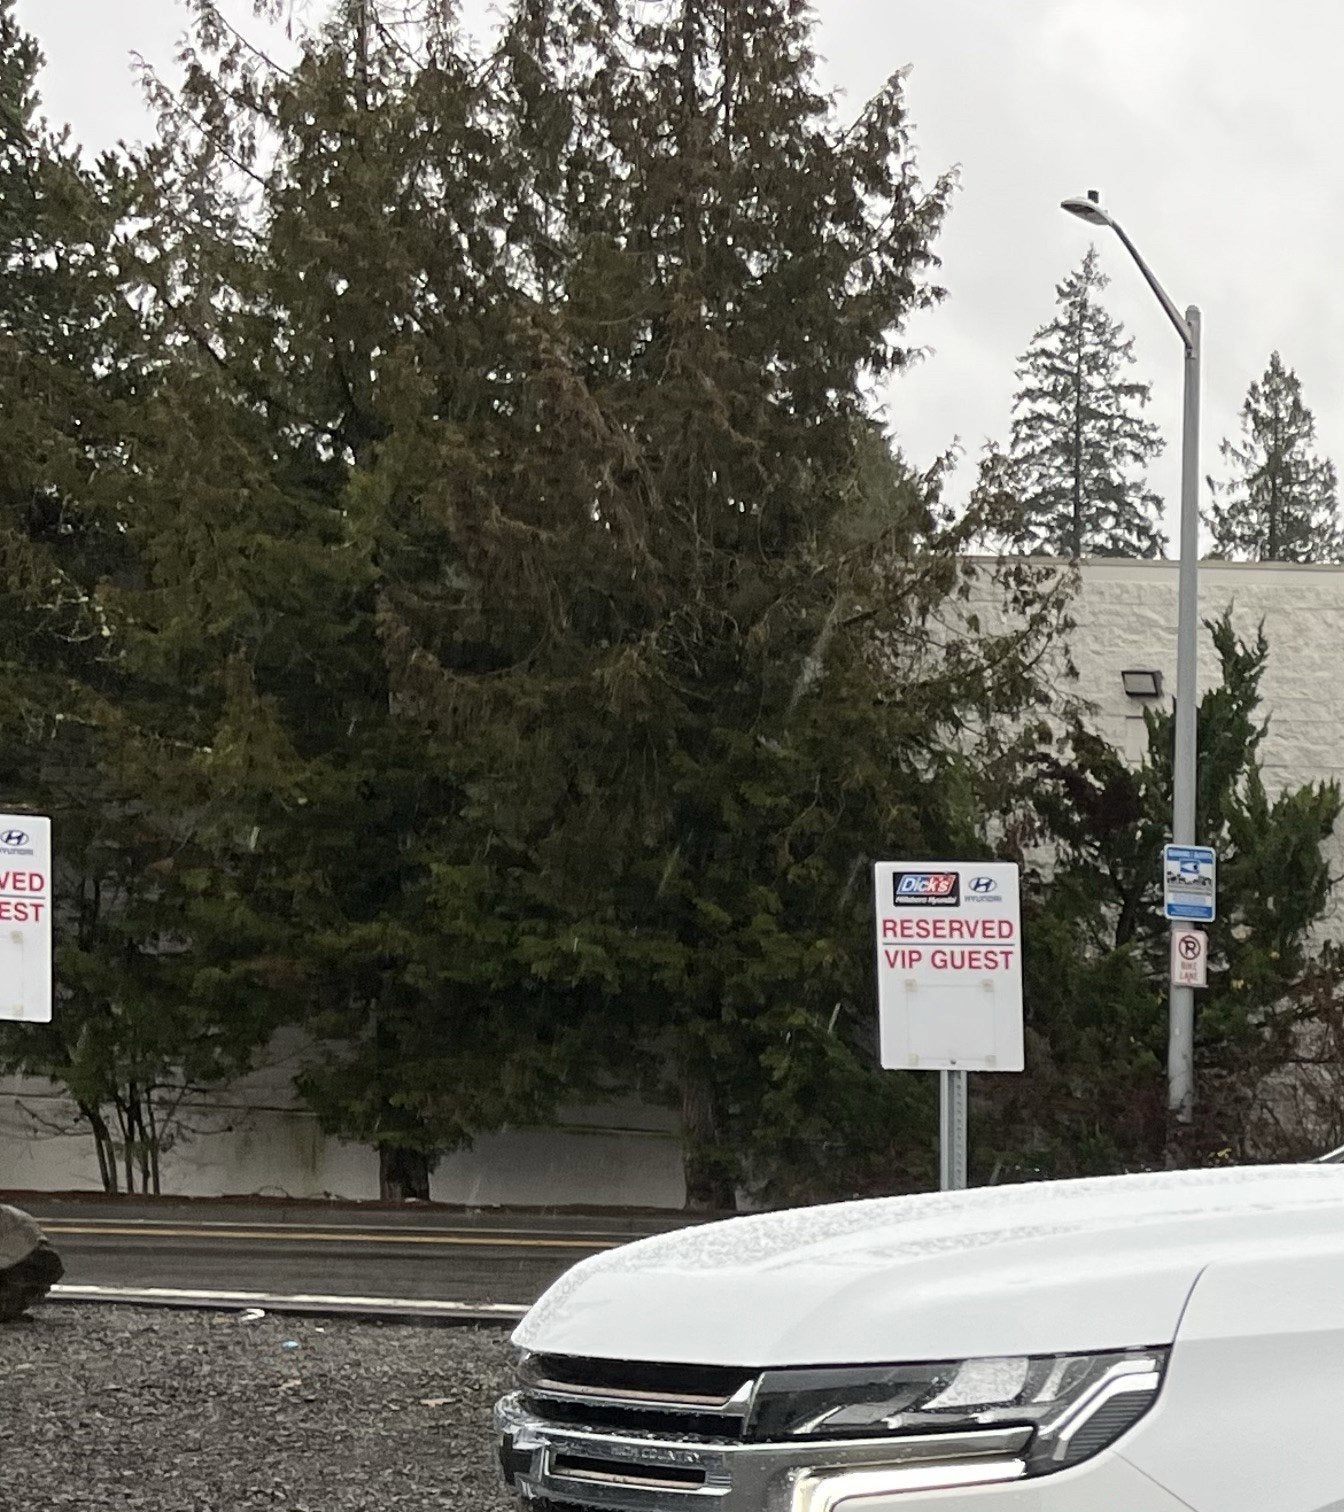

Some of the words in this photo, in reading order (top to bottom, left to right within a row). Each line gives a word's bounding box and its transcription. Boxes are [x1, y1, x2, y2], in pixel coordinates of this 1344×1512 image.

[882, 919, 1014, 939] RESERVED
[884, 949, 923, 969] VIP
[931, 950, 1014, 970] GUEST
